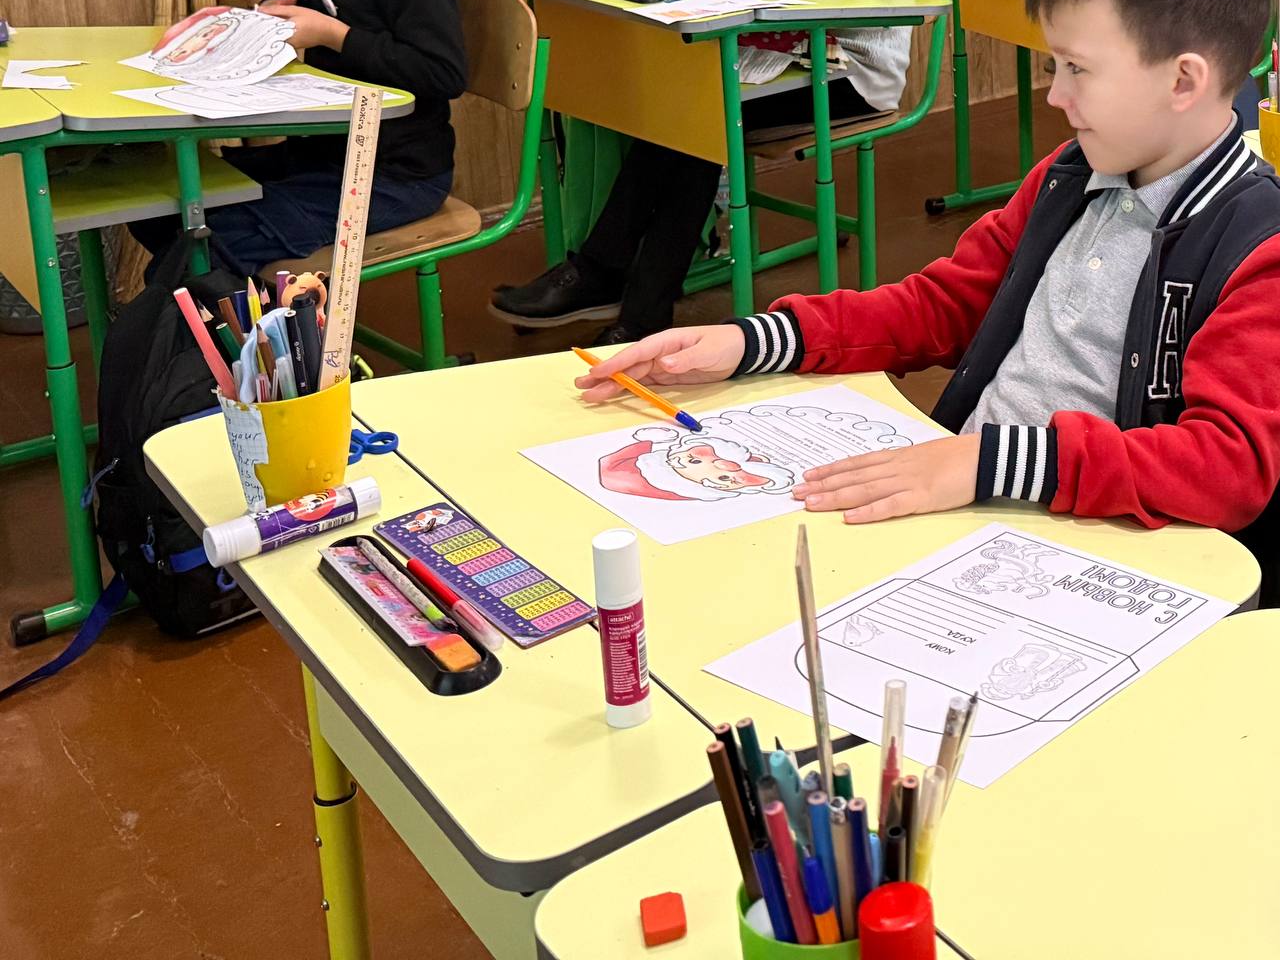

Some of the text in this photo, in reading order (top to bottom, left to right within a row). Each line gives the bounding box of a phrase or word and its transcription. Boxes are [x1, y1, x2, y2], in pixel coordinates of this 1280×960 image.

[358, 96, 368, 130] Можга
[352, 232, 358, 240] 10
[231, 432, 262, 440] your
[1080, 565, 1193, 610] ГОДОМ!
[1053, 574, 1180, 626] С НОВЫМ
[947, 629, 977, 644] КУДА
[926, 641, 957, 656] КОМУ
